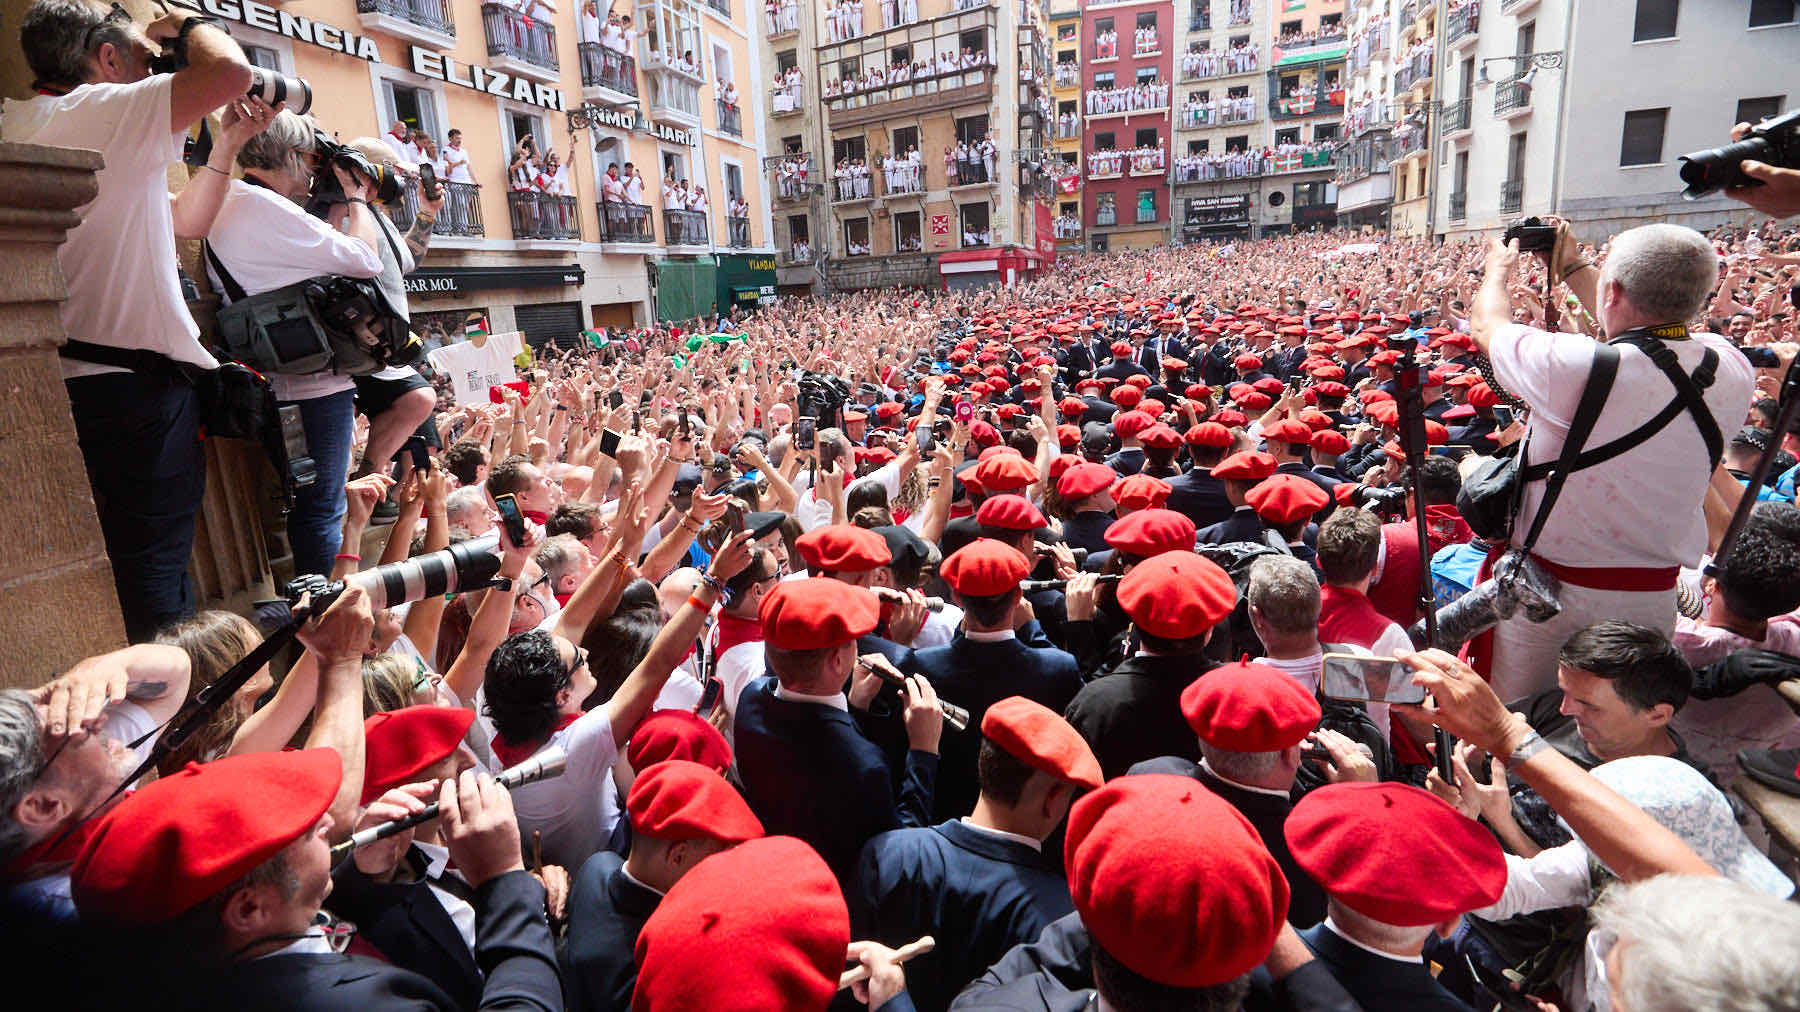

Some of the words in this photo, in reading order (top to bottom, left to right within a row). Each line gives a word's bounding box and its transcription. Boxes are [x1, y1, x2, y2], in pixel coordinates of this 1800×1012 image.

[411, 45, 567, 112] ELIZARI
[402, 279, 429, 292] BAR
[429, 278, 458, 291] MOL
